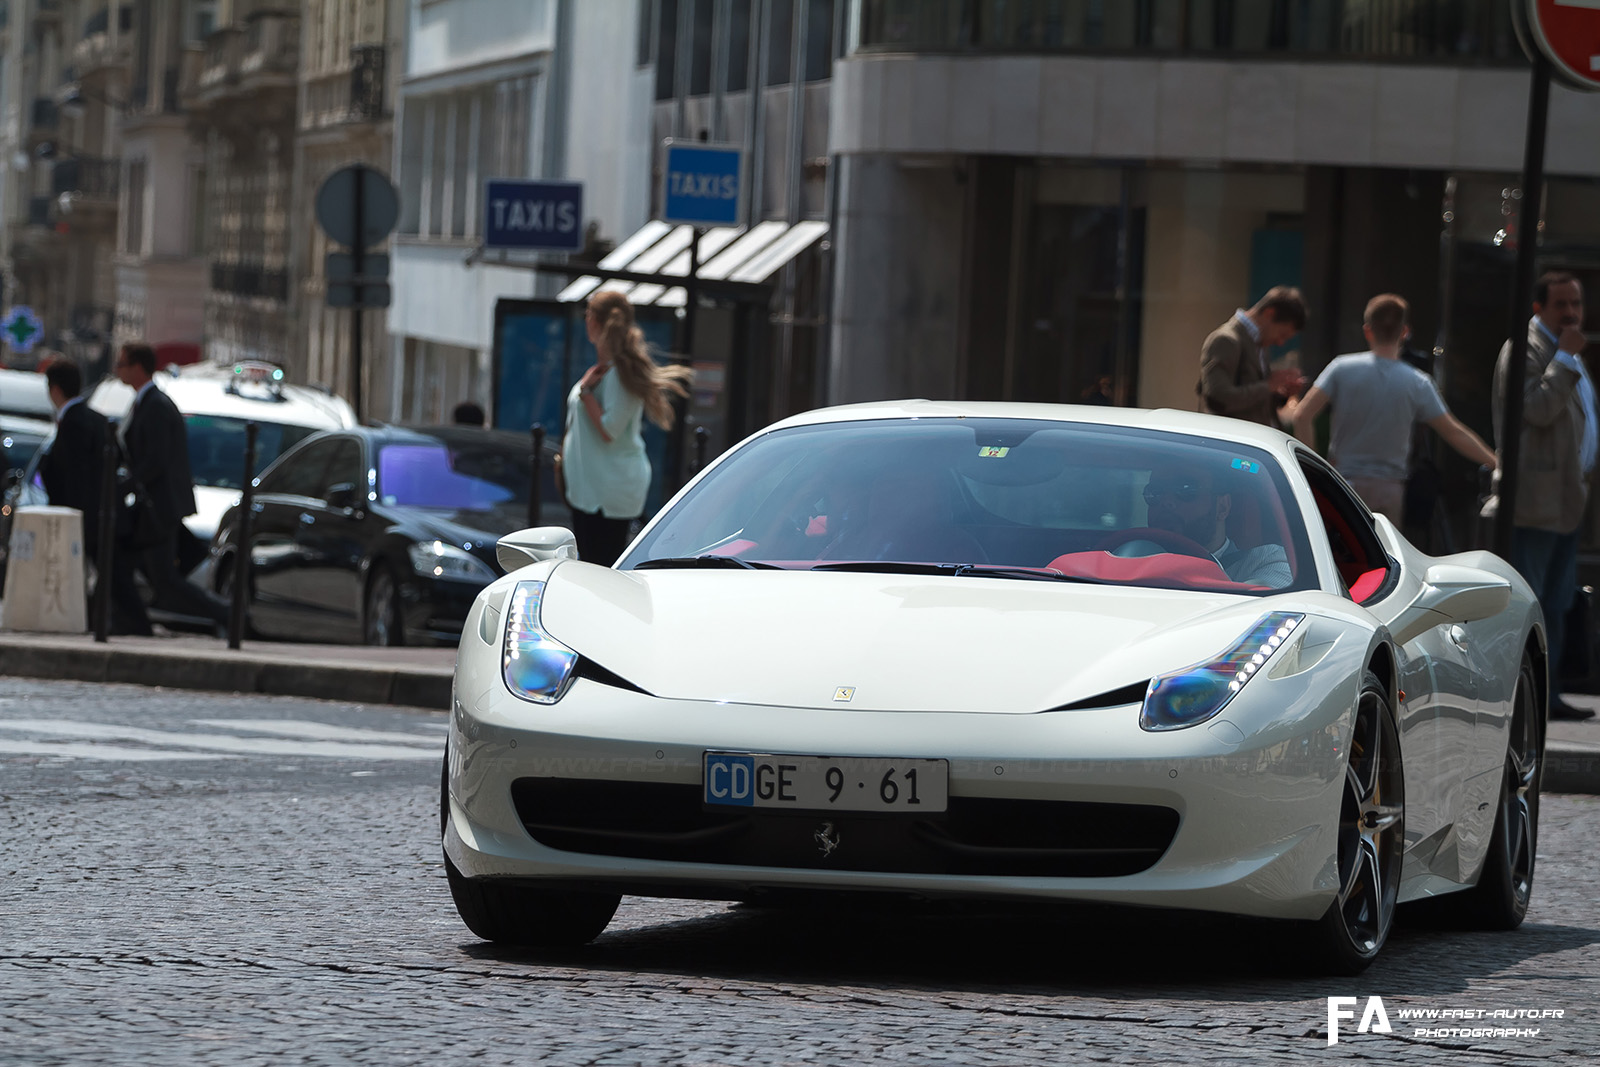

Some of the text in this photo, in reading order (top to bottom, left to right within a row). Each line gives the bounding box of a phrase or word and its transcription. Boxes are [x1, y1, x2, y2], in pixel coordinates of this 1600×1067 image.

[670, 171, 737, 200] TAXIS
[493, 199, 577, 233] TAXIS
[709, 762, 749, 799] CD
[756, 763, 797, 801] GE
